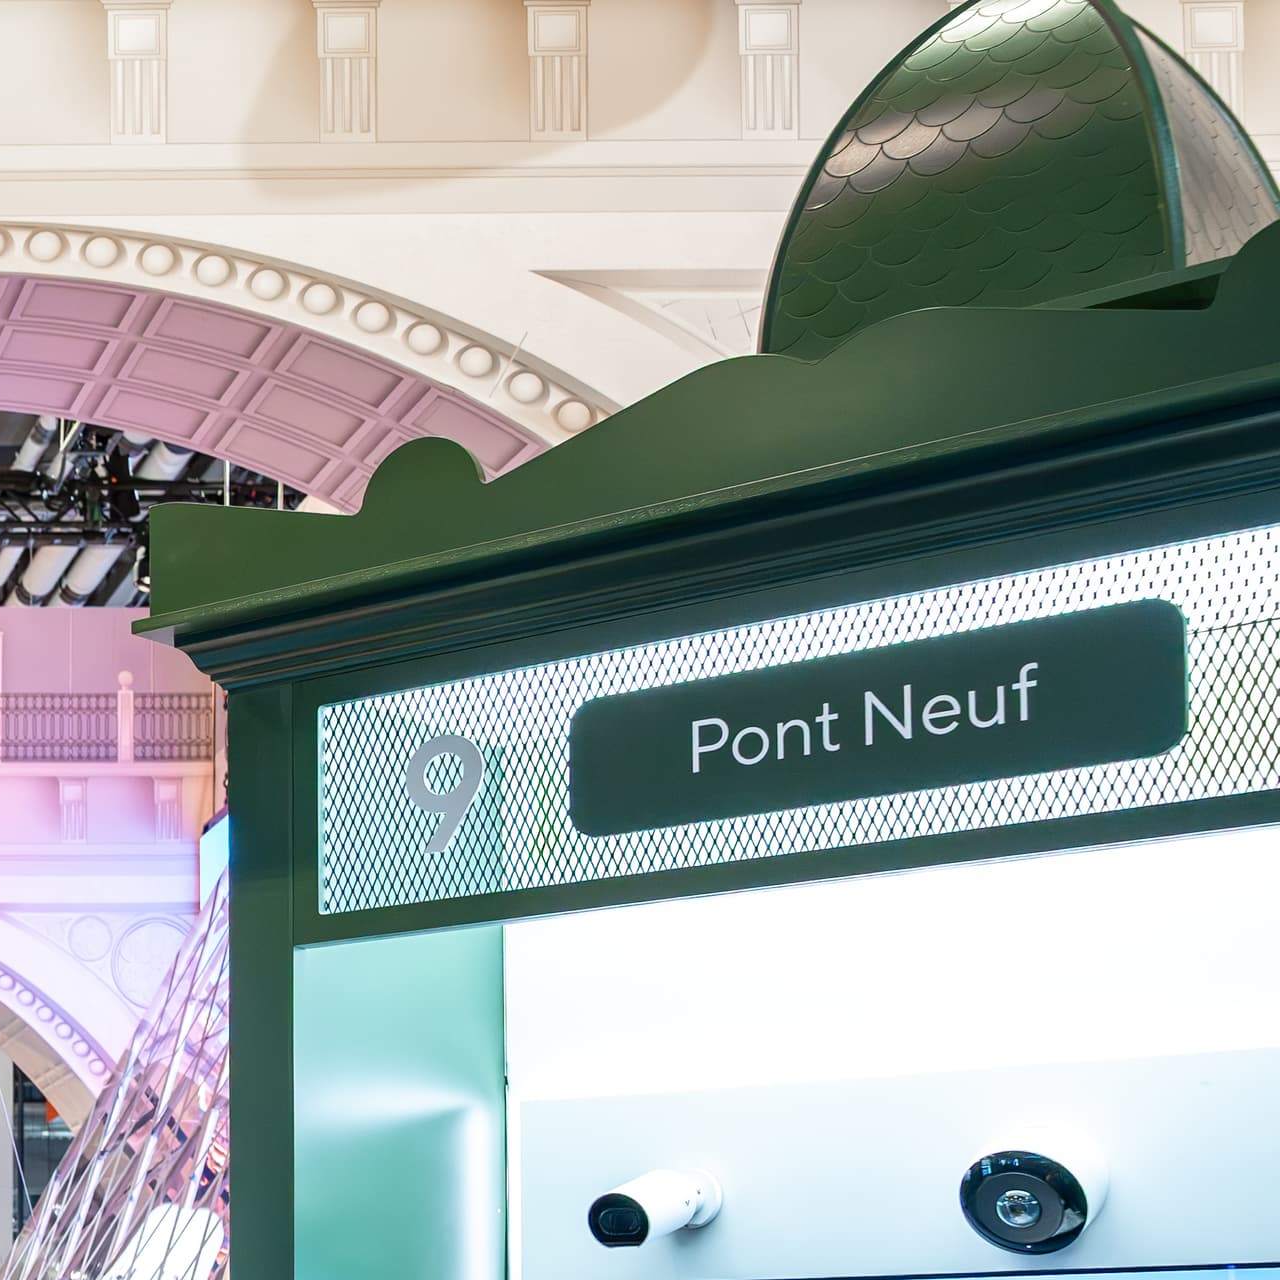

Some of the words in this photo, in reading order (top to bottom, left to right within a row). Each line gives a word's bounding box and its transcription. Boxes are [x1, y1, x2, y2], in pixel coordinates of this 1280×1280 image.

[691, 700, 842, 773] Pont
[866, 663, 1040, 740] Neuf
[405, 735, 485, 855] 9
